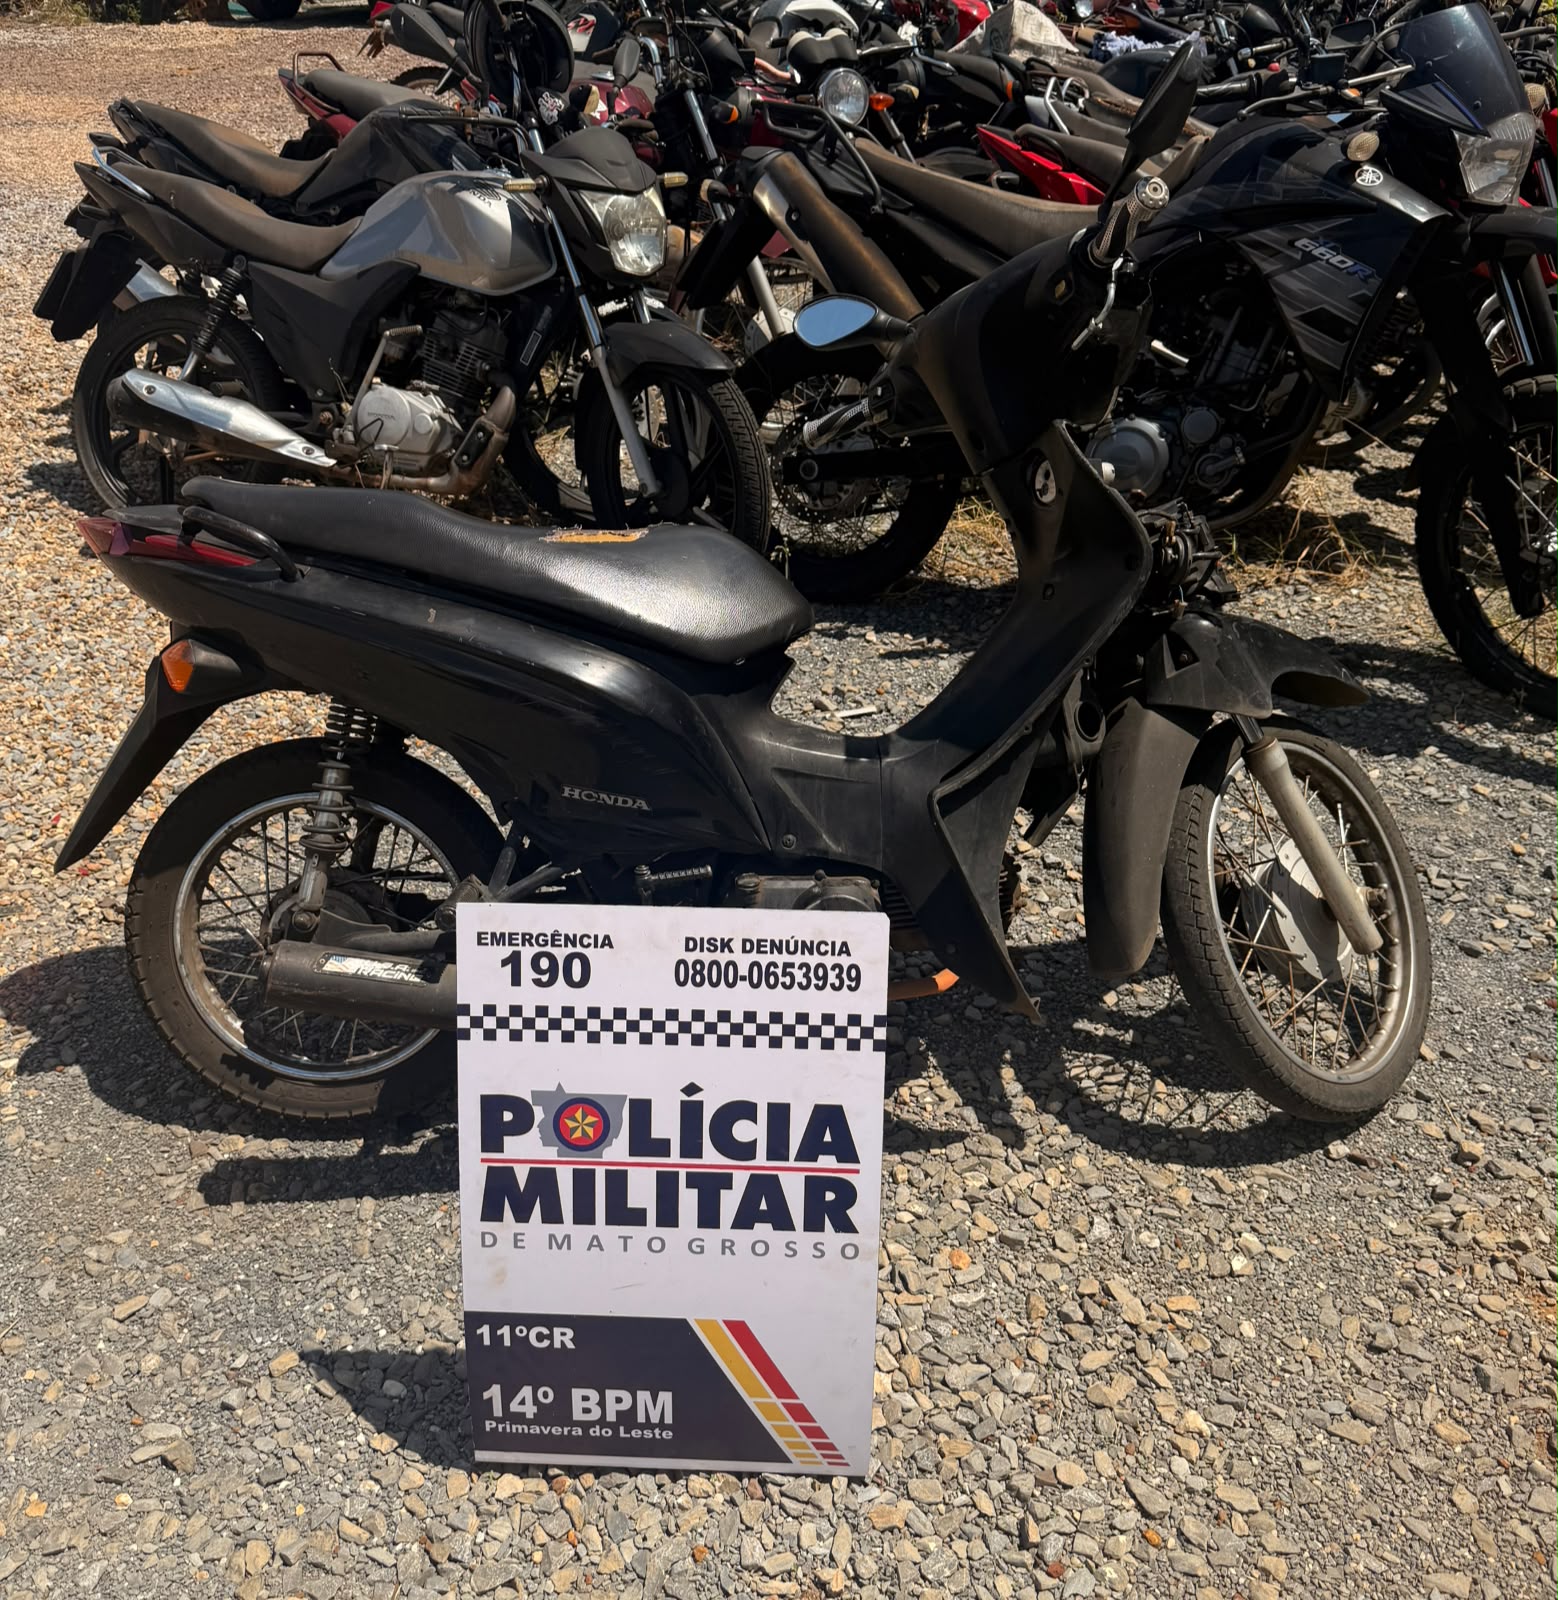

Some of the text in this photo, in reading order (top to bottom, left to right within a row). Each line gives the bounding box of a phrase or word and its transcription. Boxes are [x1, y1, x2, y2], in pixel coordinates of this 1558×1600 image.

[1294, 238, 1373, 280] 660R
[561, 785, 651, 811] HONDA
[476, 929, 614, 949] EMERGÊNCIA
[684, 935, 852, 957] DISK DENÚNCIA
[500, 950, 592, 989] 190
[674, 958, 862, 992] 0800-0653939
[480, 1081, 861, 1164] POLÍCIA
[480, 1165, 860, 1234] MILITAR
[480, 1231, 860, 1260] DE MATO GROSSO
[482, 1383, 674, 1425] 14º BPM
[485, 1420, 674, 1440] Primavera do Leste
